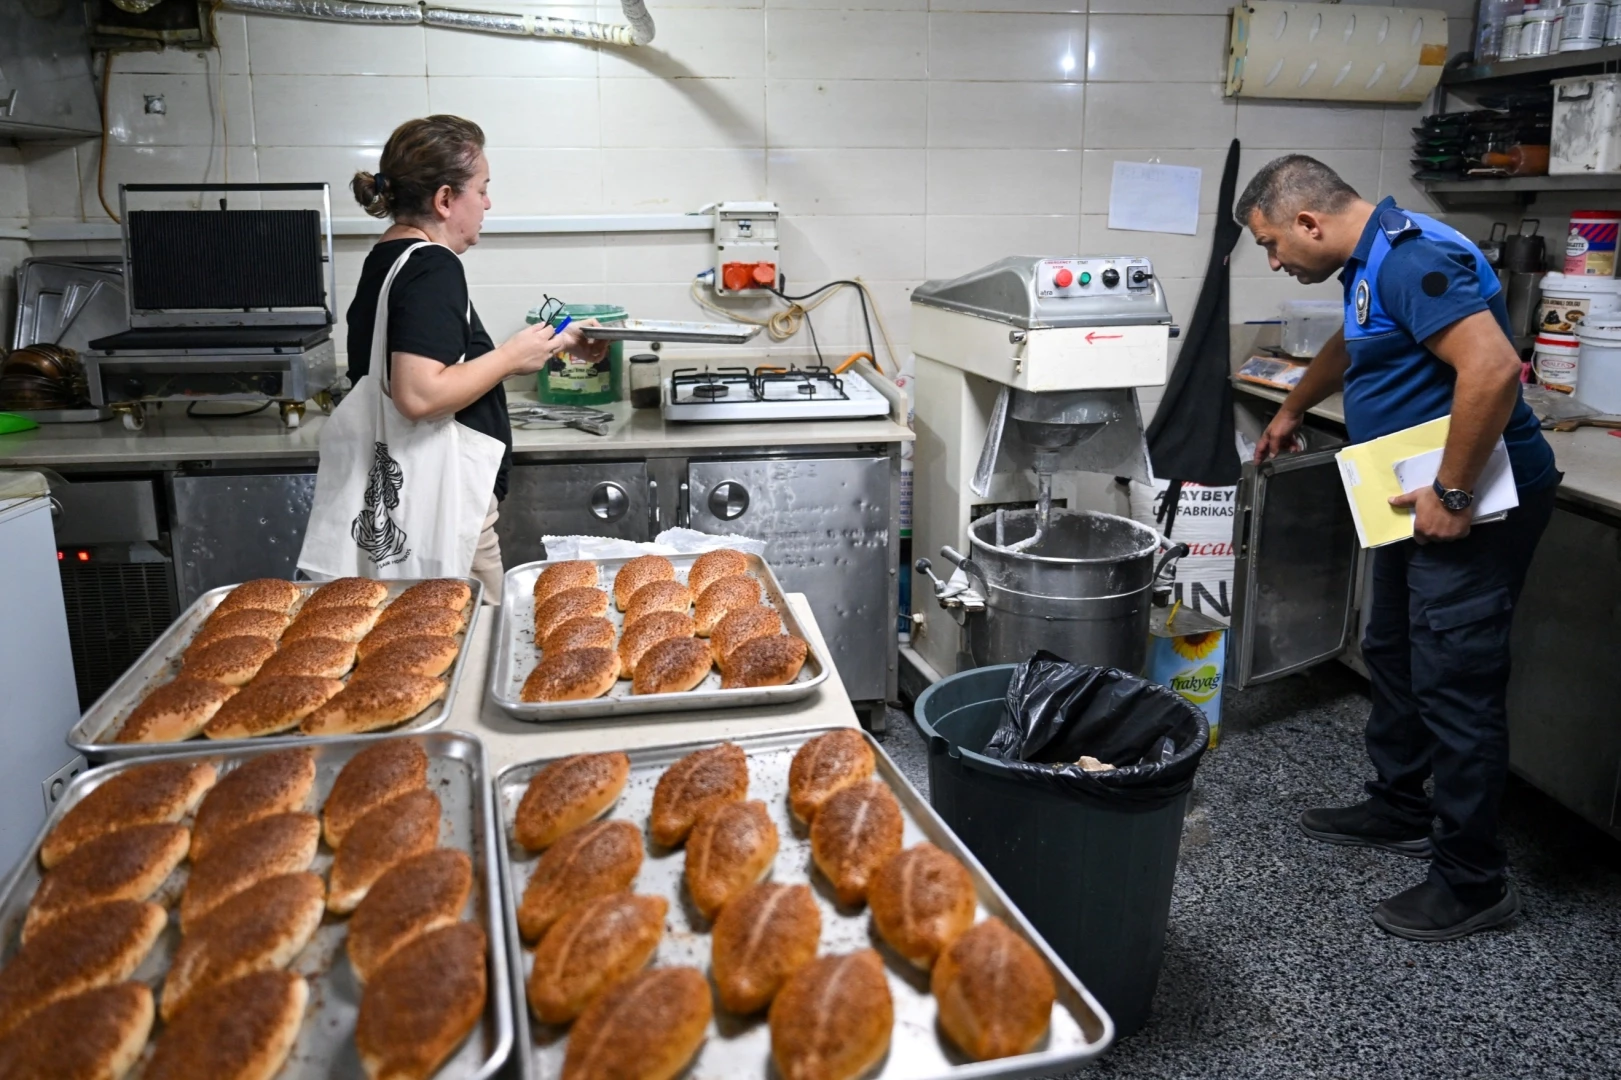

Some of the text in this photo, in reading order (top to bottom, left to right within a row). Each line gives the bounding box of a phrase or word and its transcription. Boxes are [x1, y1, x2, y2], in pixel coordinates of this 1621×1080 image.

[1153, 490, 1234, 501] AAYBEY
[1176, 504, 1234, 516] FABRİKAS
[1169, 673, 1222, 692] Trakyağ
